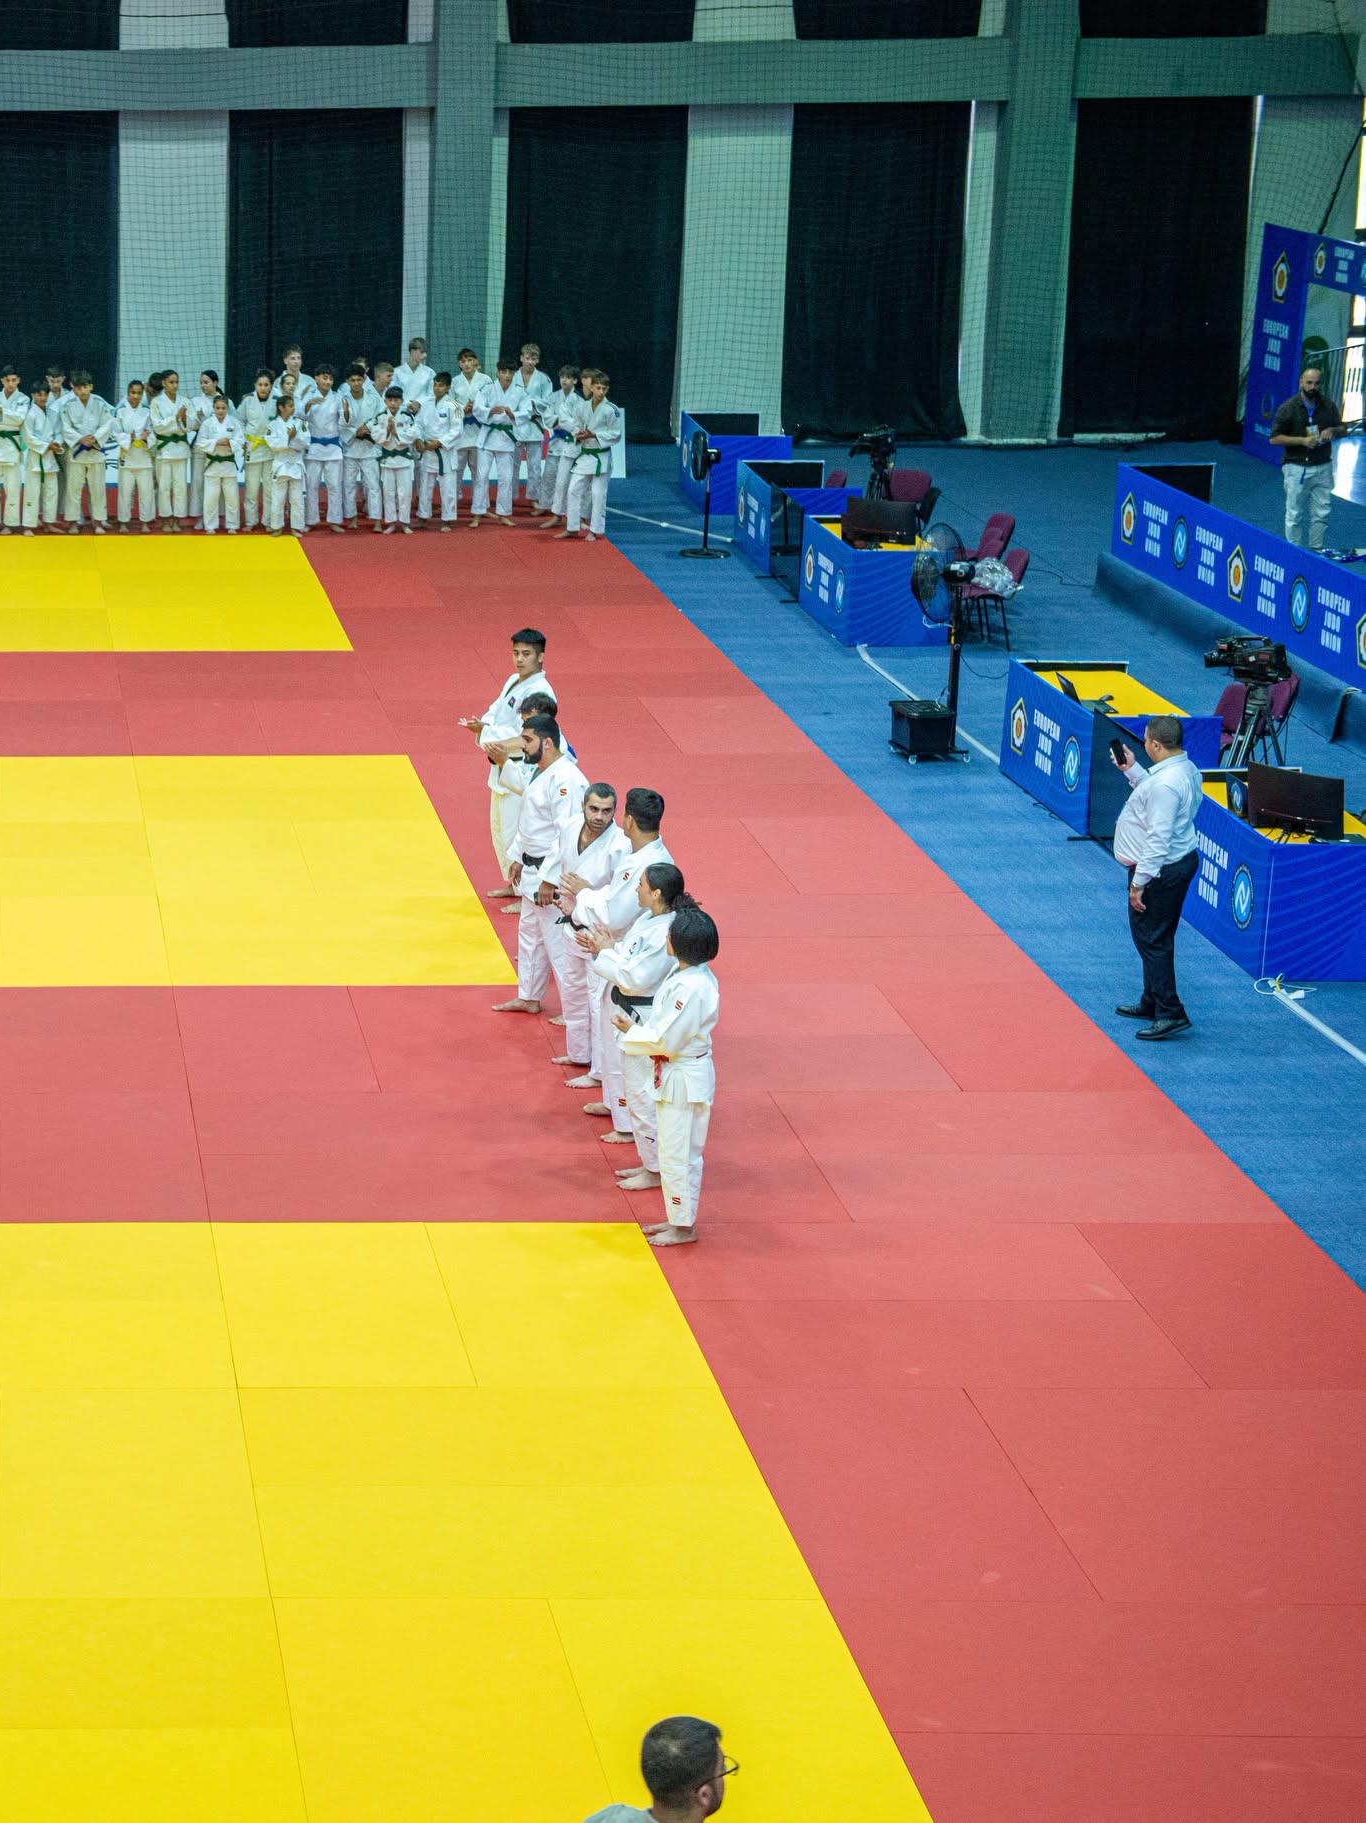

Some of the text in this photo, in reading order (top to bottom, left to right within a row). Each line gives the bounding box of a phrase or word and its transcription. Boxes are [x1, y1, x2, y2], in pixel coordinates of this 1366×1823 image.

[1143, 500, 1169, 526] EUROPEAN
[1147, 520, 1160, 540] JUDO
[1195, 525, 1223, 552] EUROPEAN
[1145, 537, 1160, 558] UNION
[1200, 547, 1214, 568] JUDO
[1197, 564, 1215, 587] UNION
[1254, 554, 1285, 584] EUROPEAN
[1260, 577, 1275, 599] JUDO
[1257, 595, 1276, 619] UNION
[1317, 586, 1350, 616] EUROPEAN
[1324, 610, 1340, 632] JUDO
[1321, 629, 1341, 654] UNION
[1034, 708, 1061, 742] EUROPEAN
[1038, 732, 1052, 756] JUDO
[1035, 750, 1052, 776] UNION
[1196, 830, 1229, 870] EUROPEAN
[1202, 857, 1218, 885] JUDO
[1198, 877, 1218, 909] UNION
